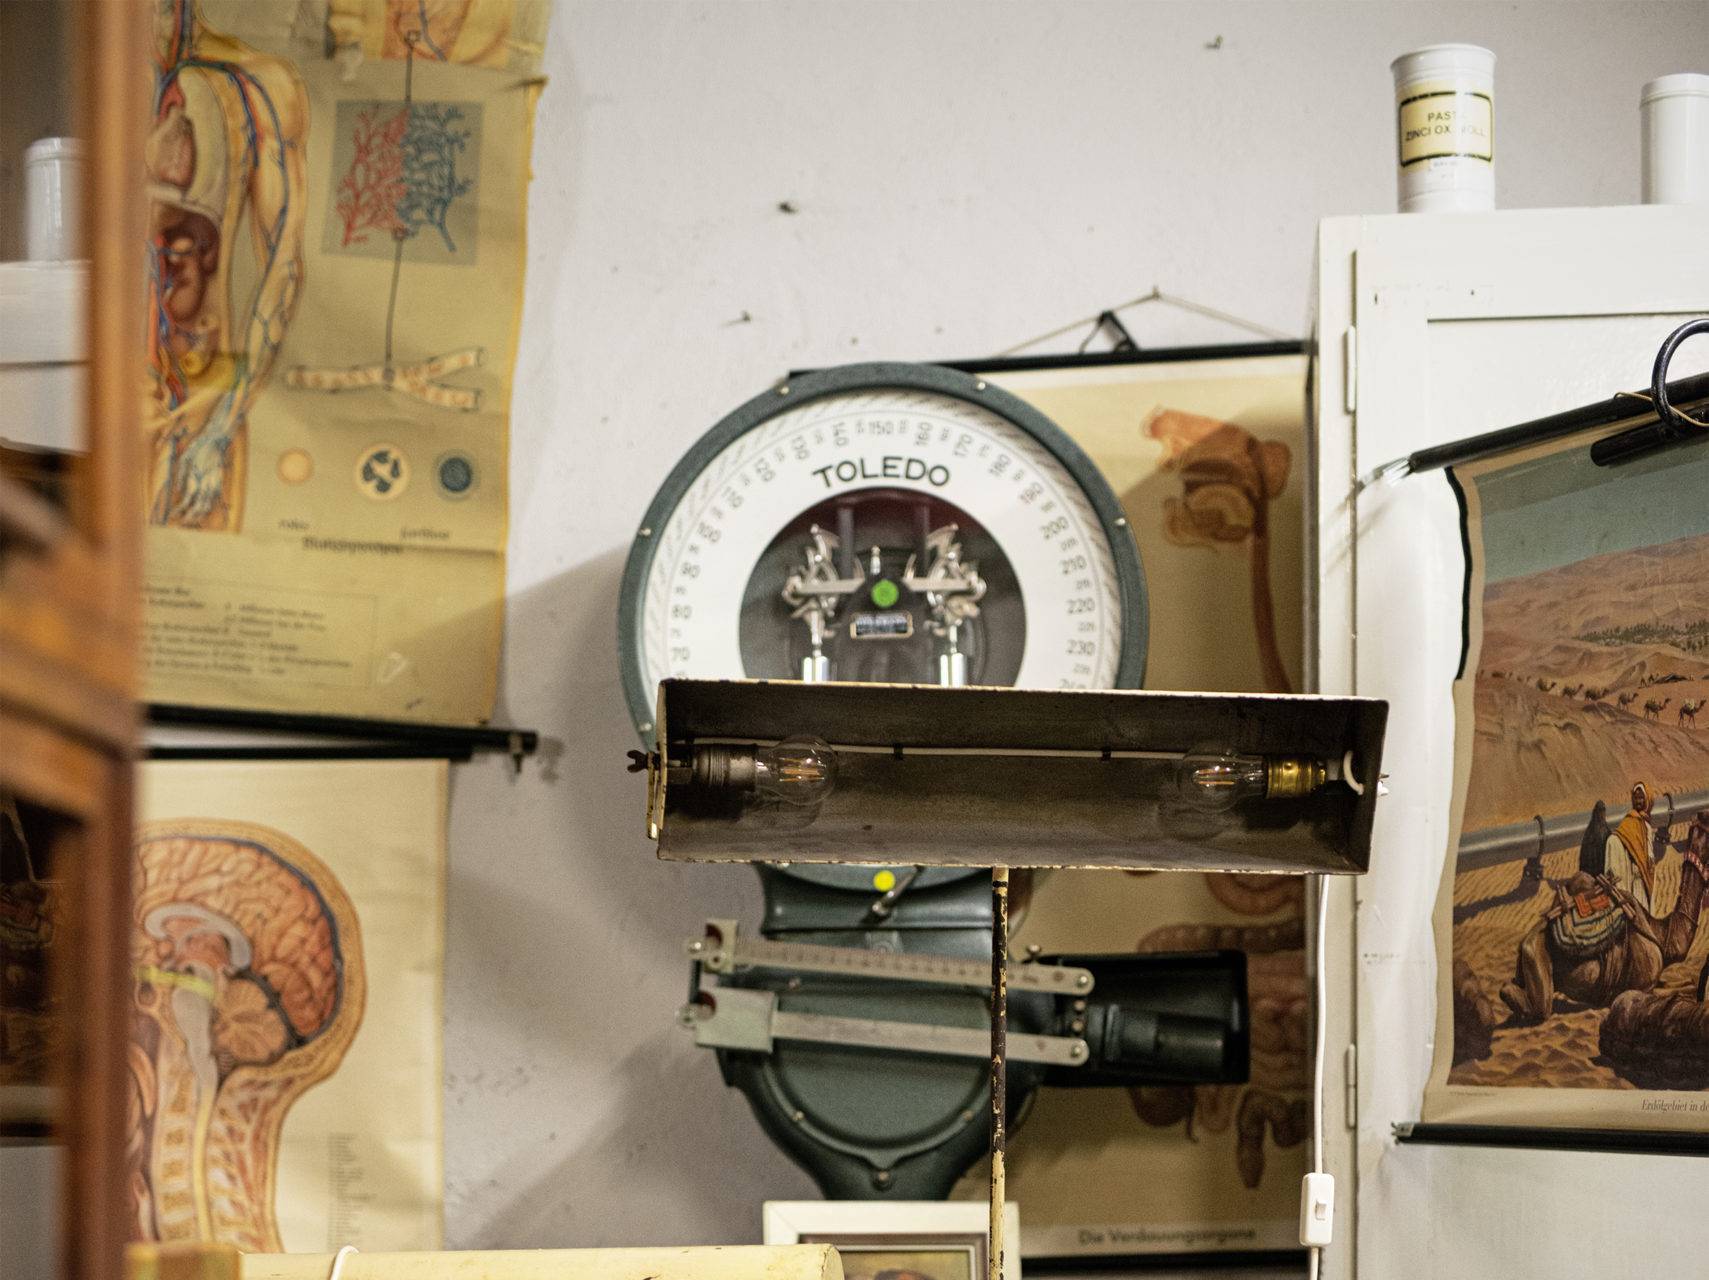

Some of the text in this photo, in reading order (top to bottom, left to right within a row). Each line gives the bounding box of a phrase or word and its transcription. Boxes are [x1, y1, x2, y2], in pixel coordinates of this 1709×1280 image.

[1427, 111, 1459, 122] PAS
[867, 420, 895, 435] 150
[914, 421, 933, 447] 160
[952, 433, 973, 458] 170
[811, 456, 950, 488] TOLEDO
[697, 521, 722, 544] 100
[1040, 516, 1069, 539] 200
[1060, 554, 1088, 575] 210
[672, 604, 692, 620] 80
[1065, 597, 1096, 615] 220
[1065, 639, 1096, 657] 230
[1642, 1099, 1687, 1113] Erdölgebiet
[1690, 1100, 1698, 1111] in
